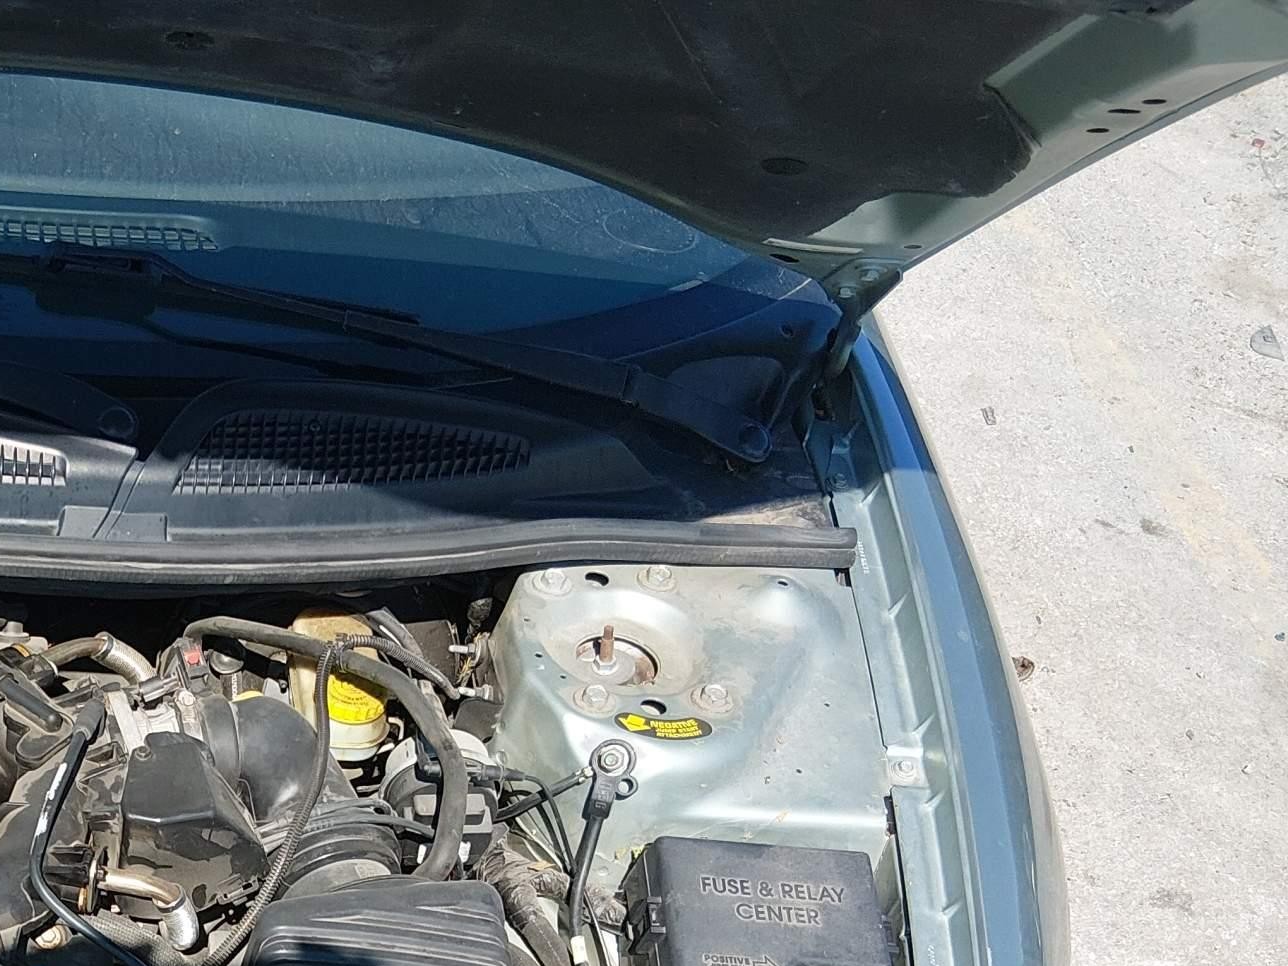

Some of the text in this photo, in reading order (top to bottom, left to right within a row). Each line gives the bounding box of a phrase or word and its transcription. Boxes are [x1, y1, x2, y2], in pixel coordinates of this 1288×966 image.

[650, 719, 698, 729] NEGATIVE
[700, 876, 845, 903] FUSE & RELAY
[735, 902, 821, 926] CENTER
[703, 954, 751, 965] POSITIVE
